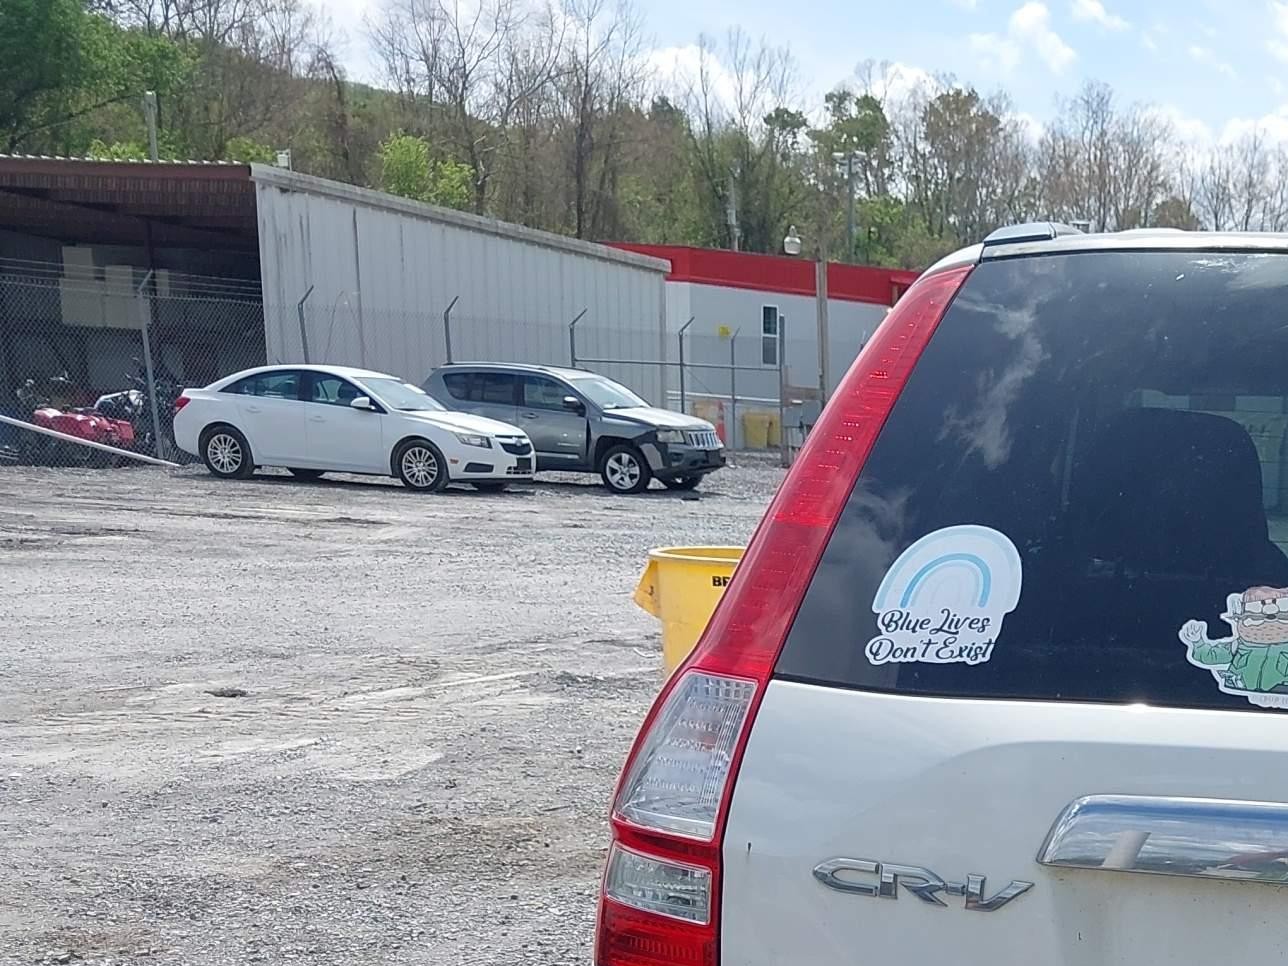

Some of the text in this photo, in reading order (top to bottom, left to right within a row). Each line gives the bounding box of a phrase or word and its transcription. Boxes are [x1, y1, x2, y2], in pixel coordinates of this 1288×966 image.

[881, 608, 991, 635] Blue Lives
[868, 636, 996, 661] Don't Exist
[812, 857, 1035, 912] CR-V
